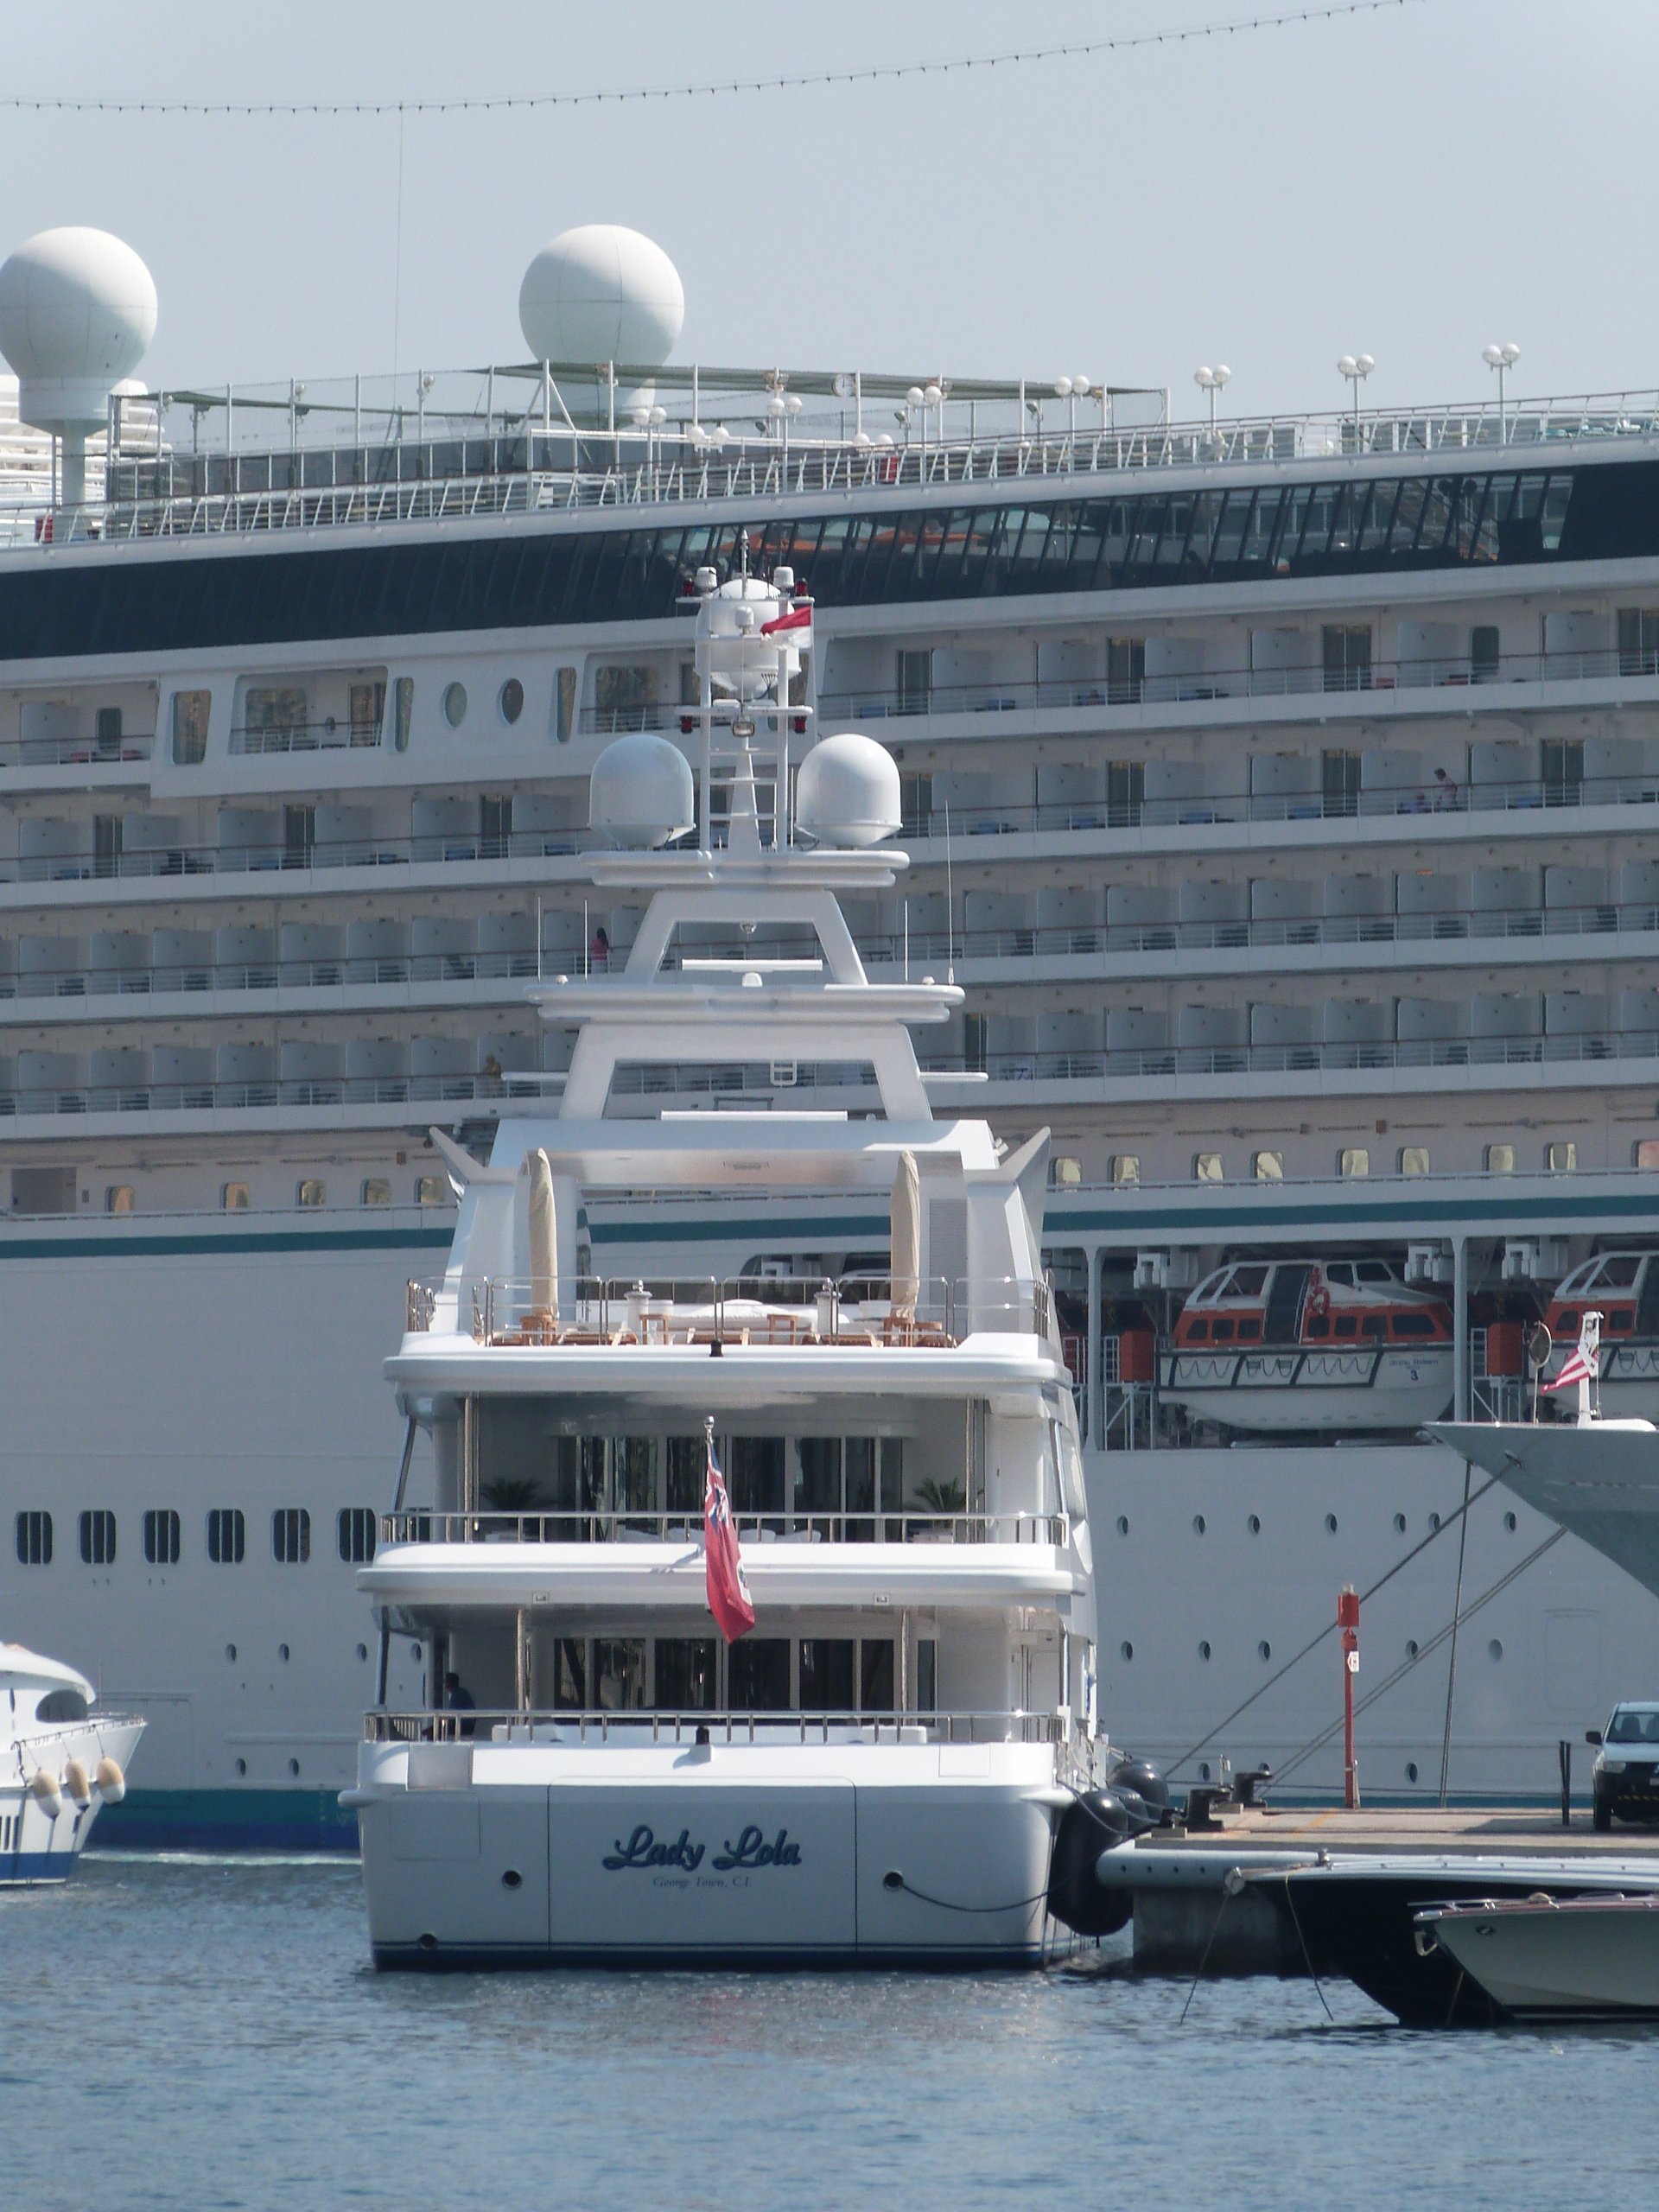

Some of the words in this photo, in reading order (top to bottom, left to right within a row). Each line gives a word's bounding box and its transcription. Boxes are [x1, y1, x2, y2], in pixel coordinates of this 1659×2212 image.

[1410, 1369, 1419, 1381] 3
[602, 1825, 705, 1872] Lady
[712, 1825, 802, 1871] Lola
[652, 1876, 690, 1889] George
